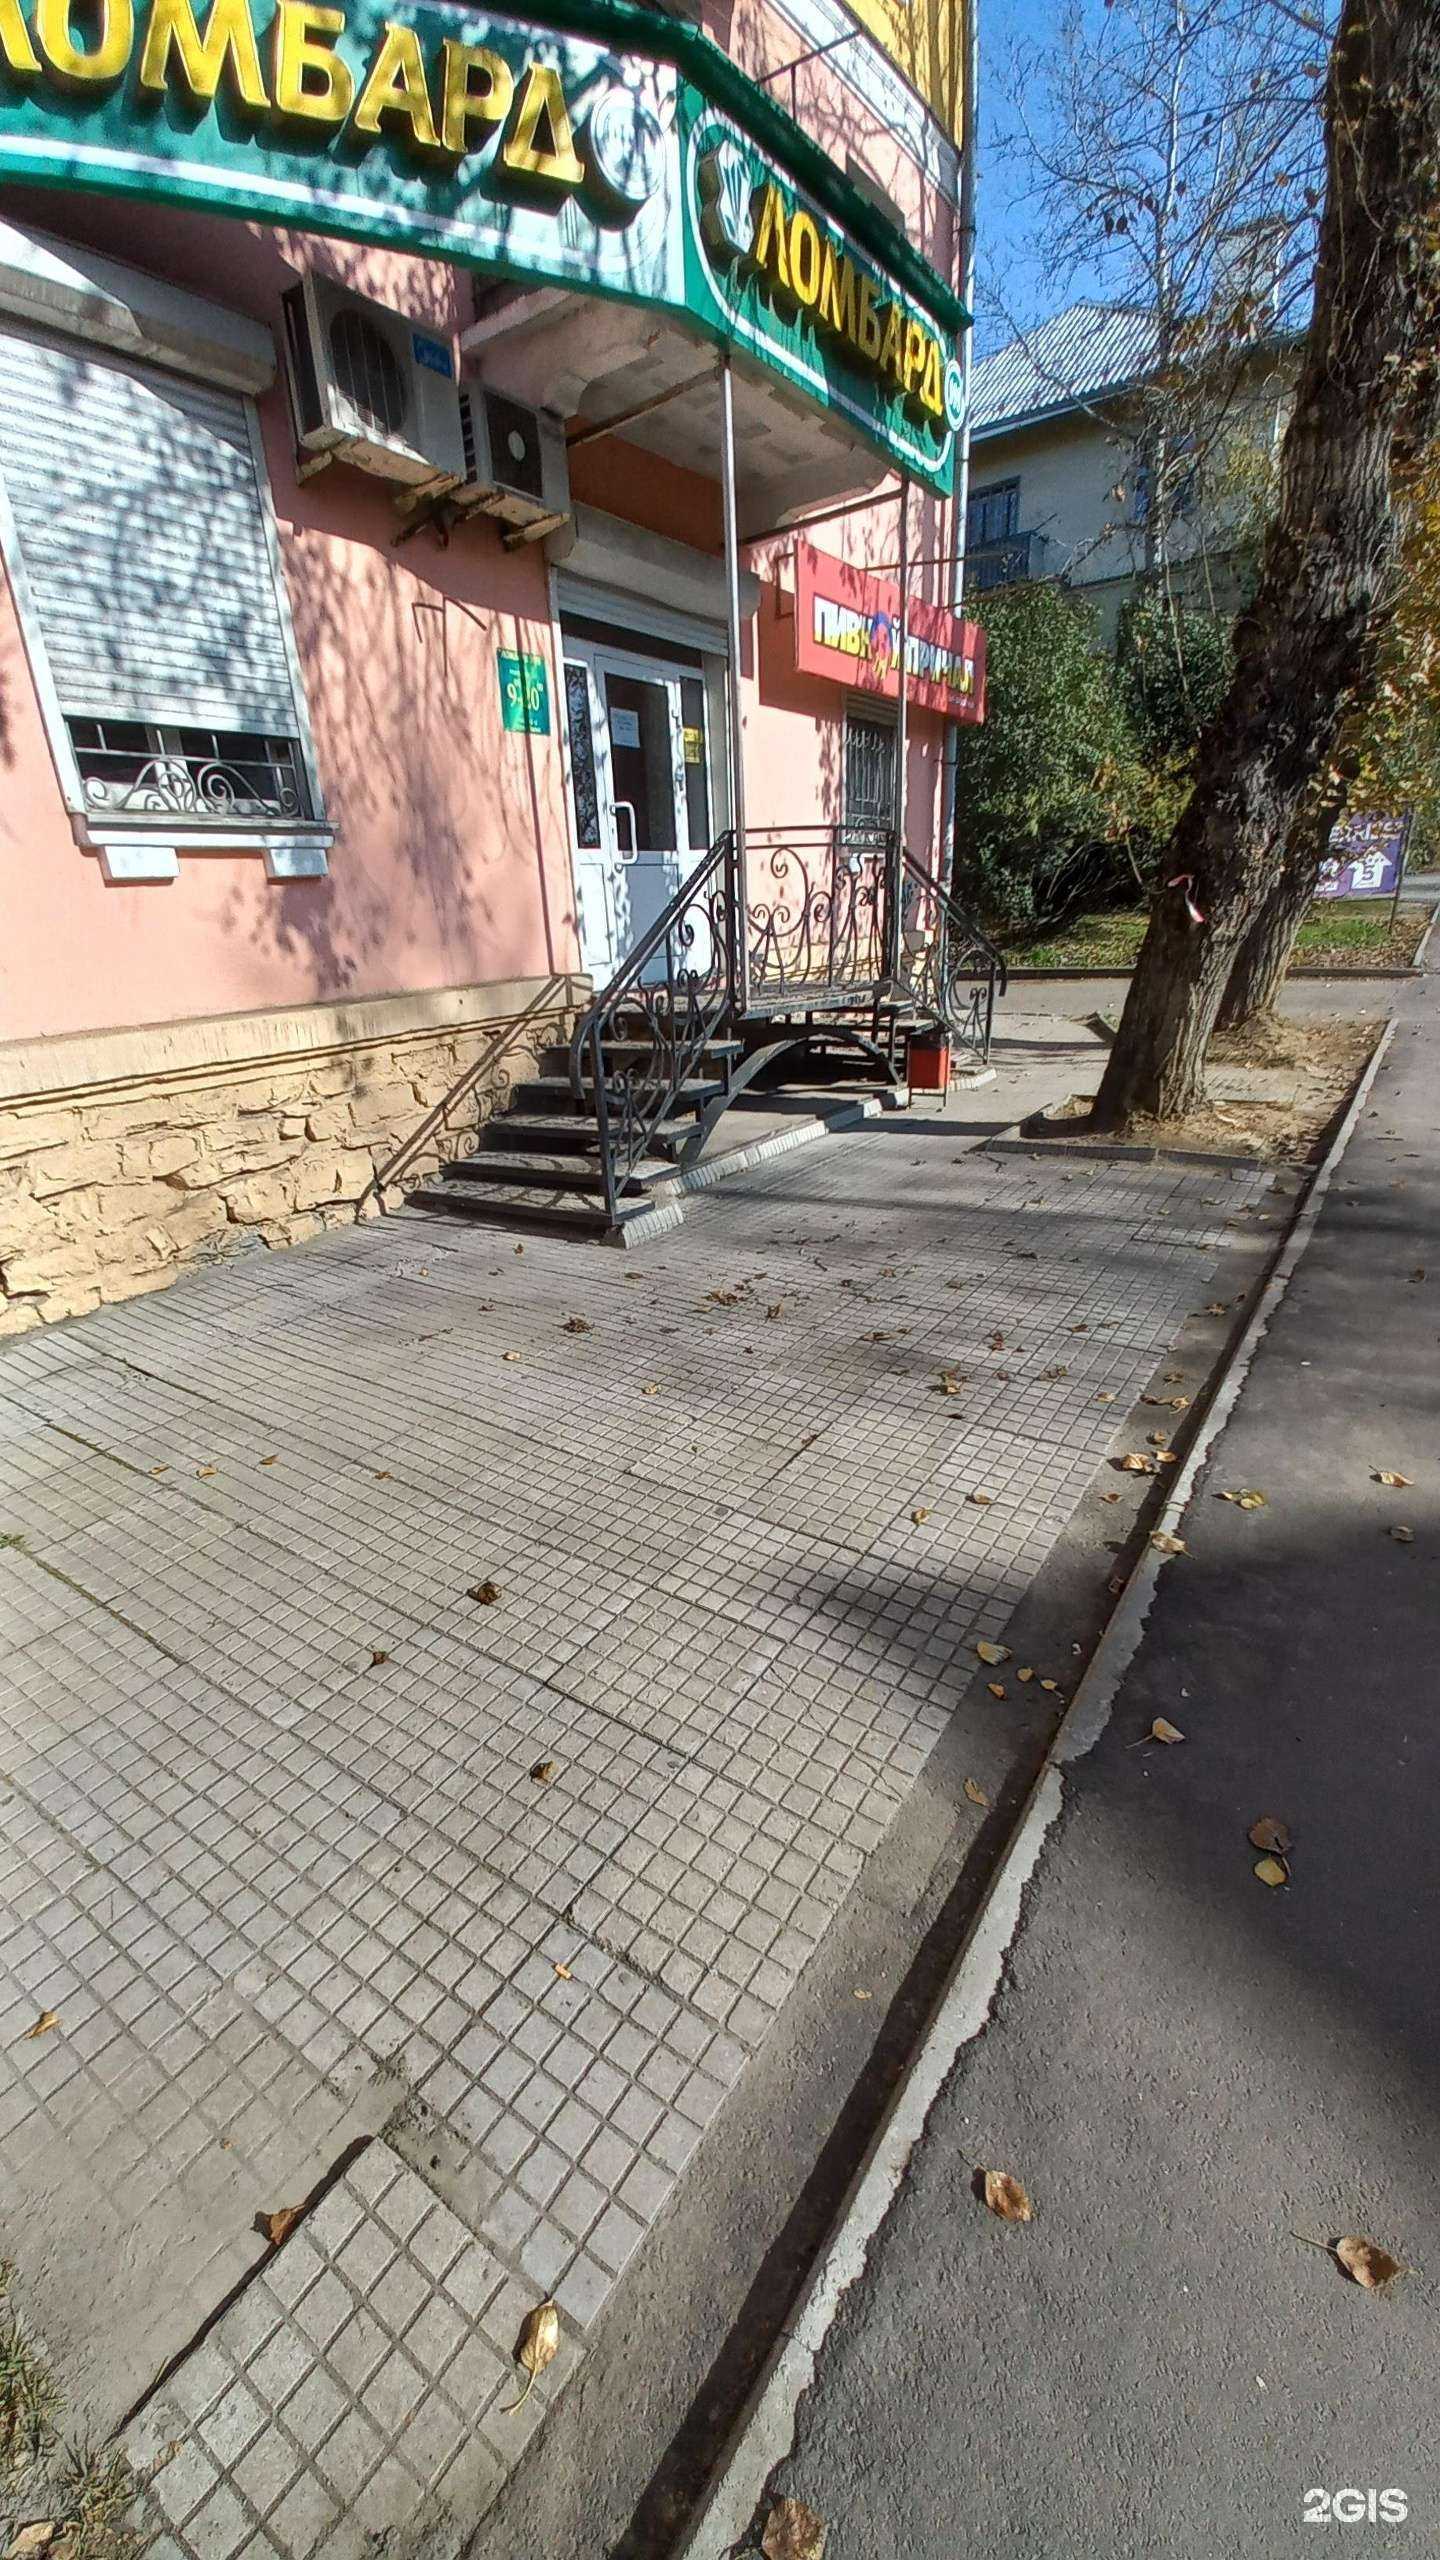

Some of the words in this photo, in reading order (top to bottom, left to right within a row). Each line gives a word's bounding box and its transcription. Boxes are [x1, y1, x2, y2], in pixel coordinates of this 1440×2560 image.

[757, 183, 944, 417] ЛОМБАРД
[813, 595, 901, 673] ПИВНЙ
[906, 635, 975, 695] ПРИЧАЛ
